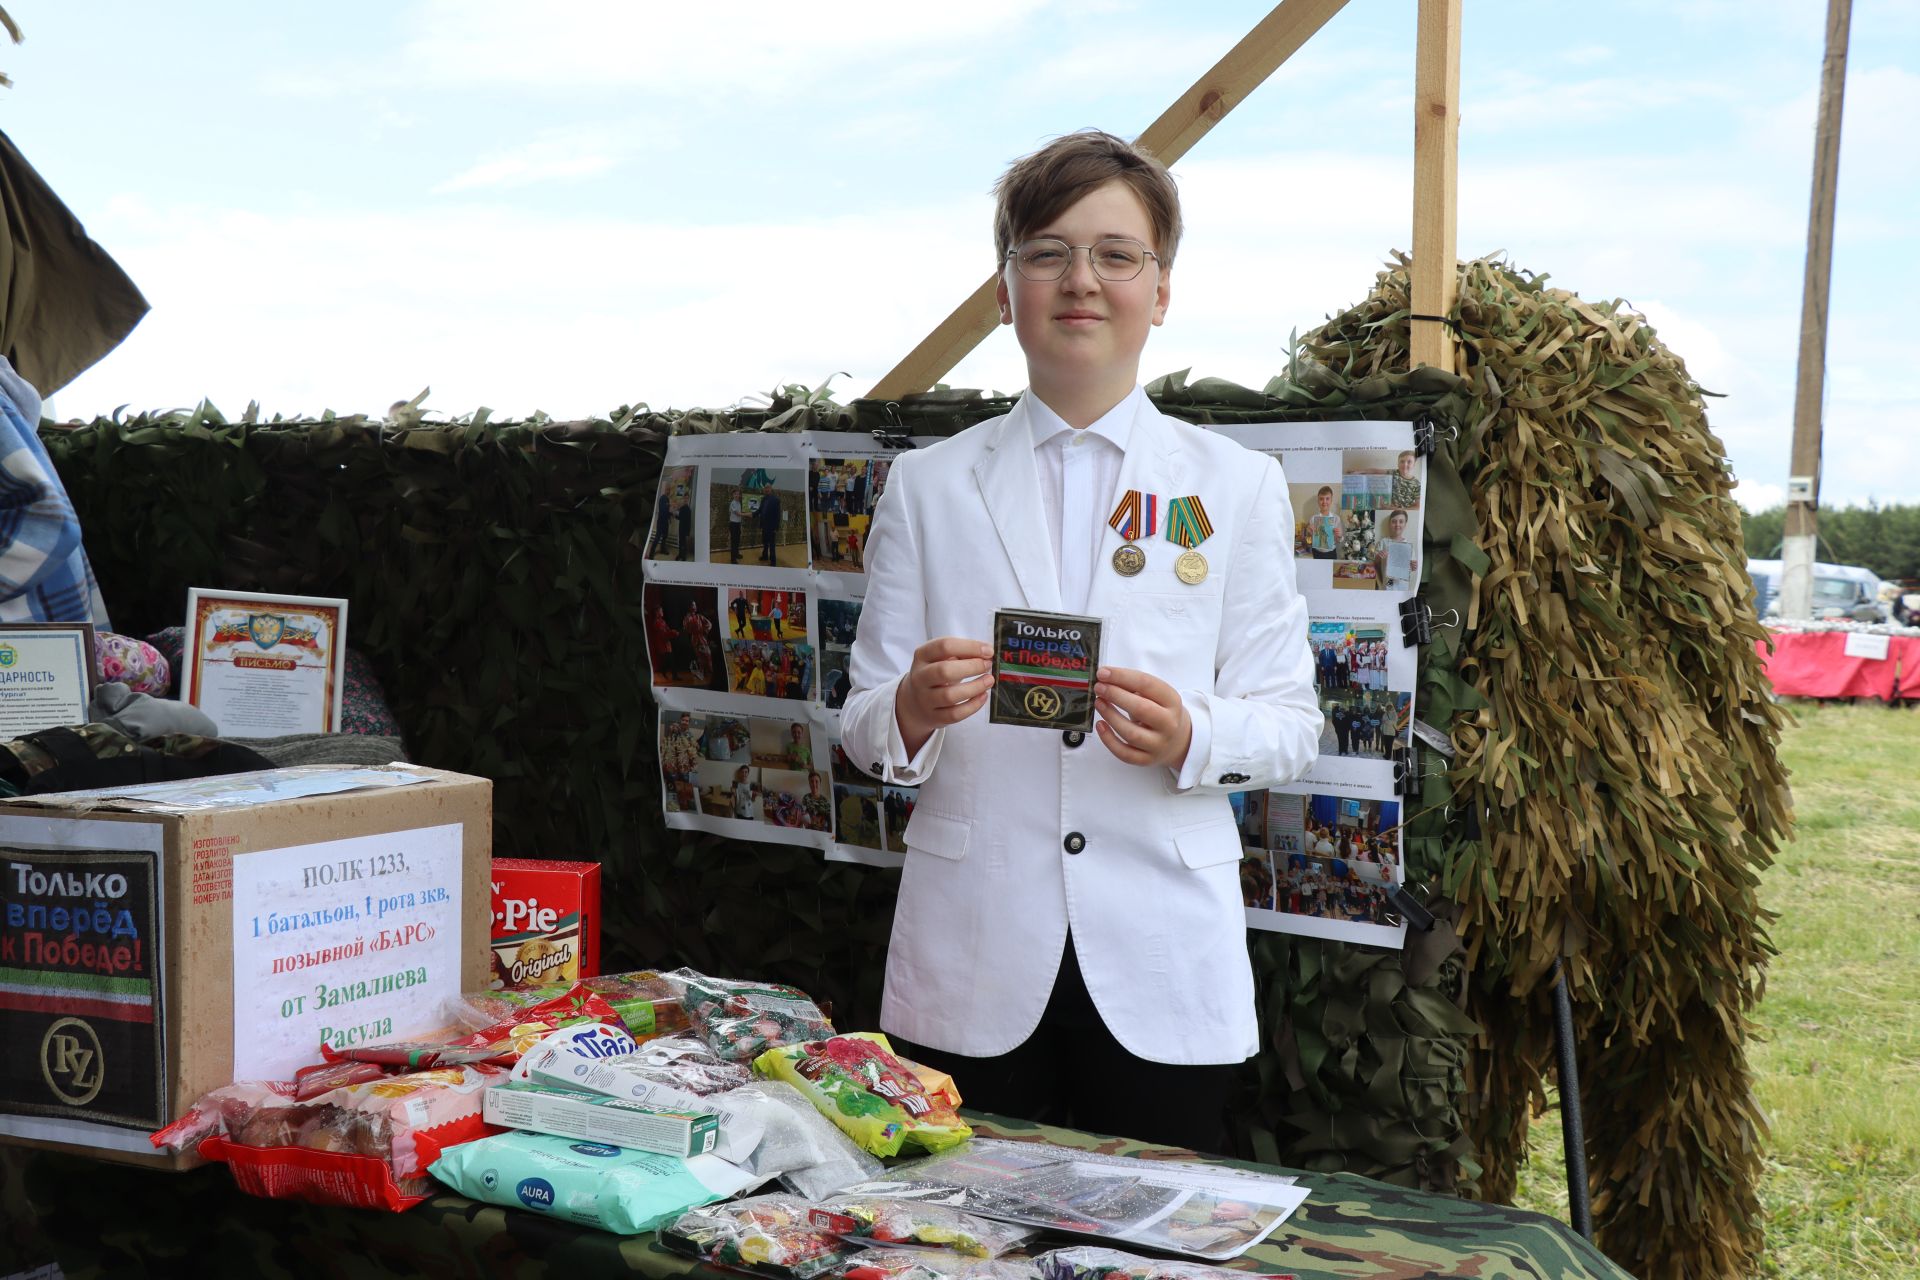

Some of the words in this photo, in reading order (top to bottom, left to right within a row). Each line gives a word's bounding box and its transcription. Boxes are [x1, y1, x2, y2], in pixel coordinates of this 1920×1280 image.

[1013, 621, 1081, 640] Только
[1007, 637, 1084, 657] вперёд
[239, 657, 292, 669] ПИСЬМО
[1019, 650, 1088, 671] Победе!
[193, 834, 240, 850] ИЗГОТОВЛЕНО
[193, 847, 229, 862] (РОЗЛИТО)
[193, 863, 199, 871] И
[193, 872, 212, 883] ДАТА
[303, 859, 363, 889] ПОЛК
[369, 852, 410, 877] 1233,
[10, 863, 128, 899] Только
[193, 892, 221, 904] НОМЕРУ
[7, 901, 138, 939] вперёд
[252, 916, 260, 938] 1
[268, 901, 361, 935] батальон,
[365, 895, 372, 916] 1
[378, 892, 416, 919] рота
[420, 886, 450, 905] зкв,
[23, 931, 144, 974] Победе!
[271, 936, 365, 975] позывной
[369, 921, 436, 953] «БАРС»
[511, 944, 572, 983] Original
[280, 995, 307, 1019] от
[312, 966, 428, 1011] Замалиева
[319, 1016, 393, 1050] Расула
[521, 1185, 550, 1202] AURA
